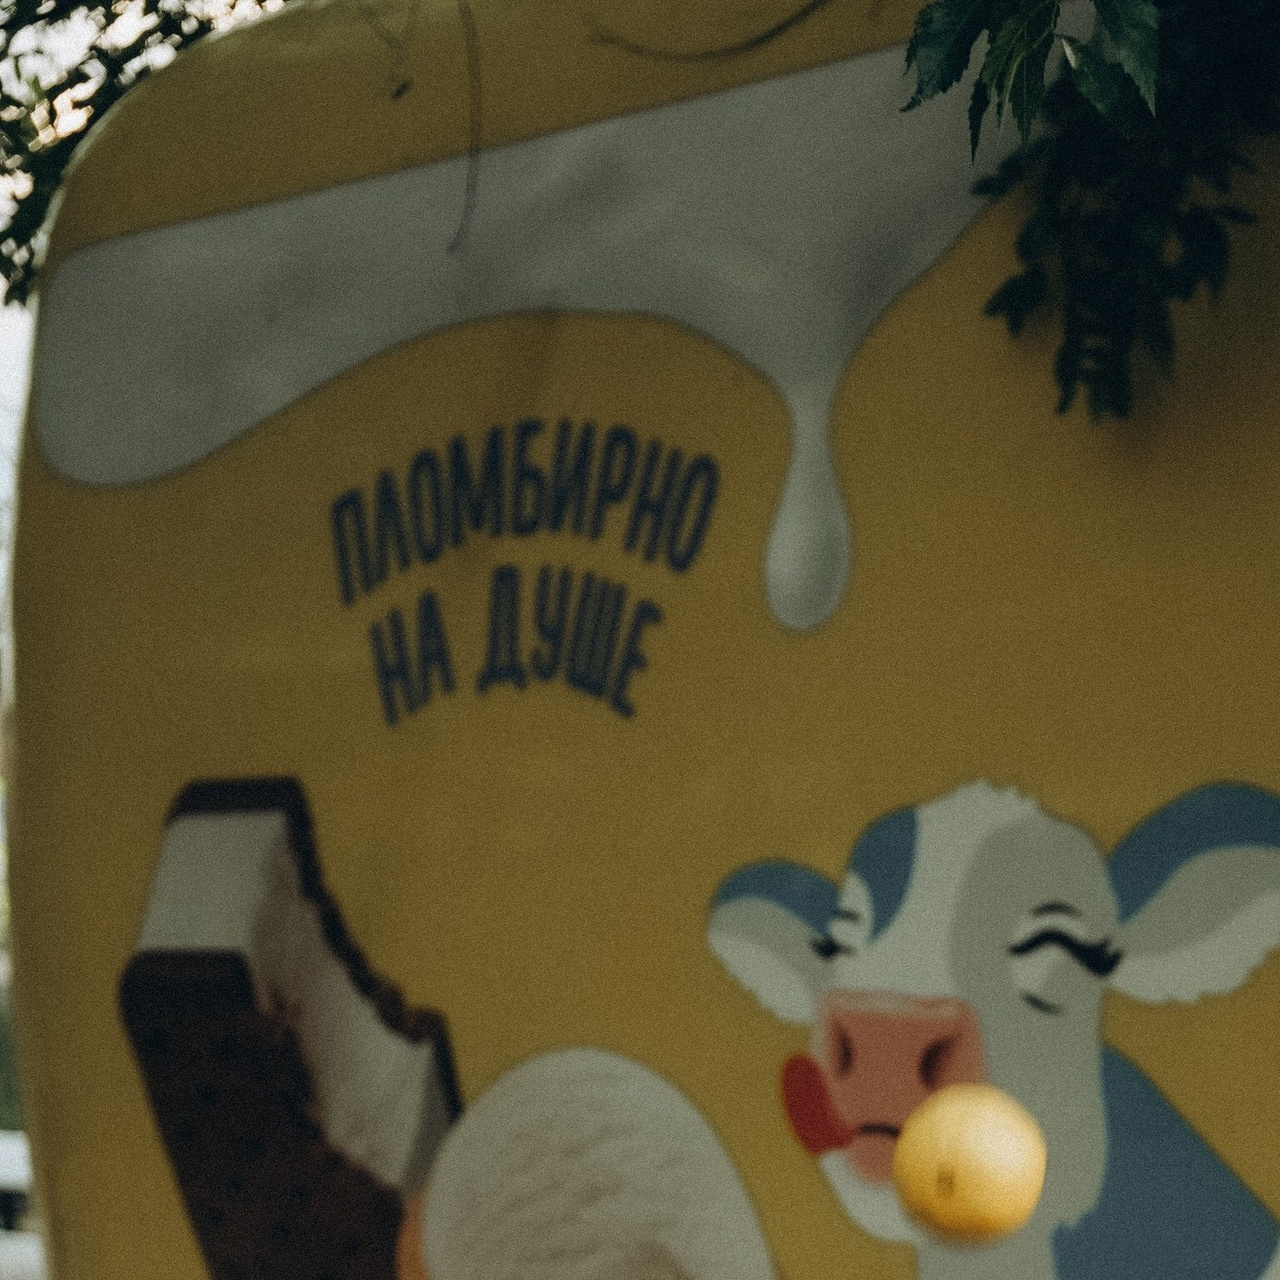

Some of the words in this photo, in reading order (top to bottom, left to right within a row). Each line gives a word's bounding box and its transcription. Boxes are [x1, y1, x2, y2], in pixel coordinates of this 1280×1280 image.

[331, 418, 719, 604] ПЛОМБИРНО
[370, 591, 455, 724] НА
[477, 565, 662, 718] ДУШЕ
